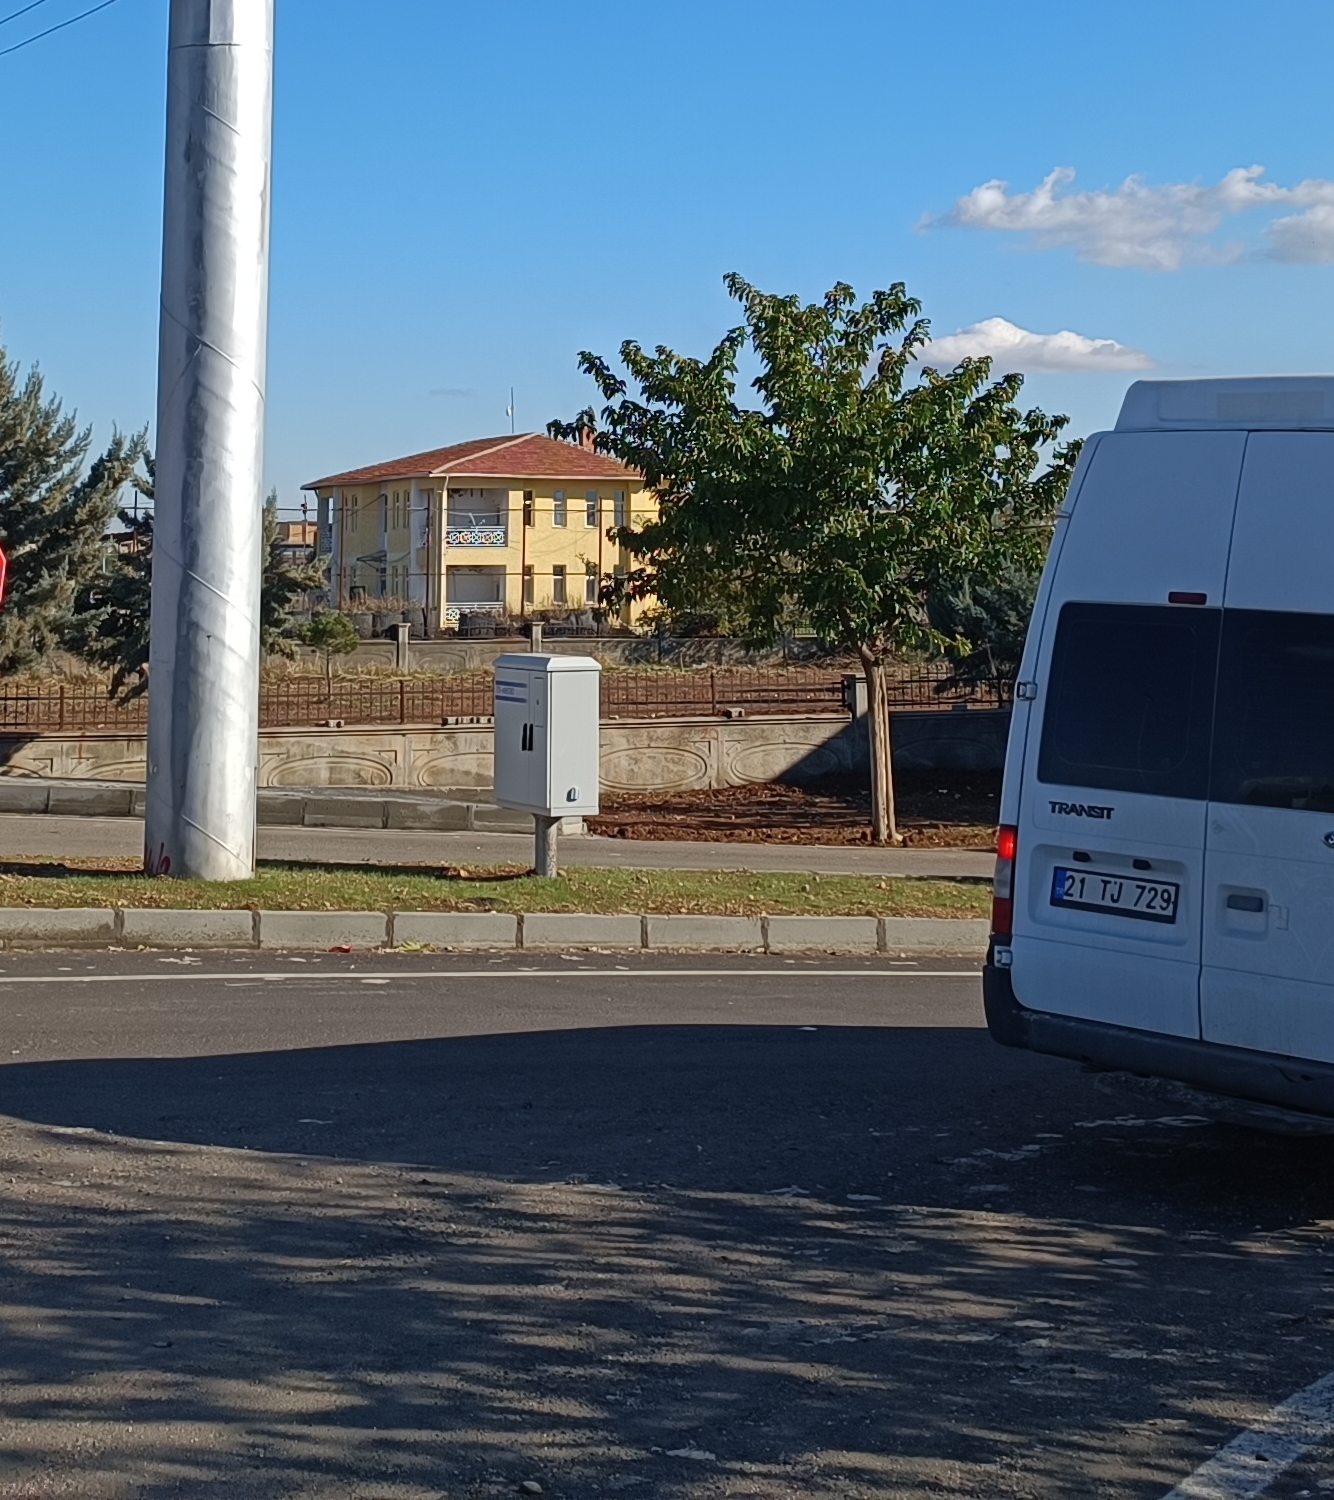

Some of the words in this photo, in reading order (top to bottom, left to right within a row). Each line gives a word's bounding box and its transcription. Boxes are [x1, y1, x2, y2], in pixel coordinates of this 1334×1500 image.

[1064, 875, 1086, 899] 21
[1100, 879, 1123, 904] TJ
[1134, 884, 1172, 911] 729
